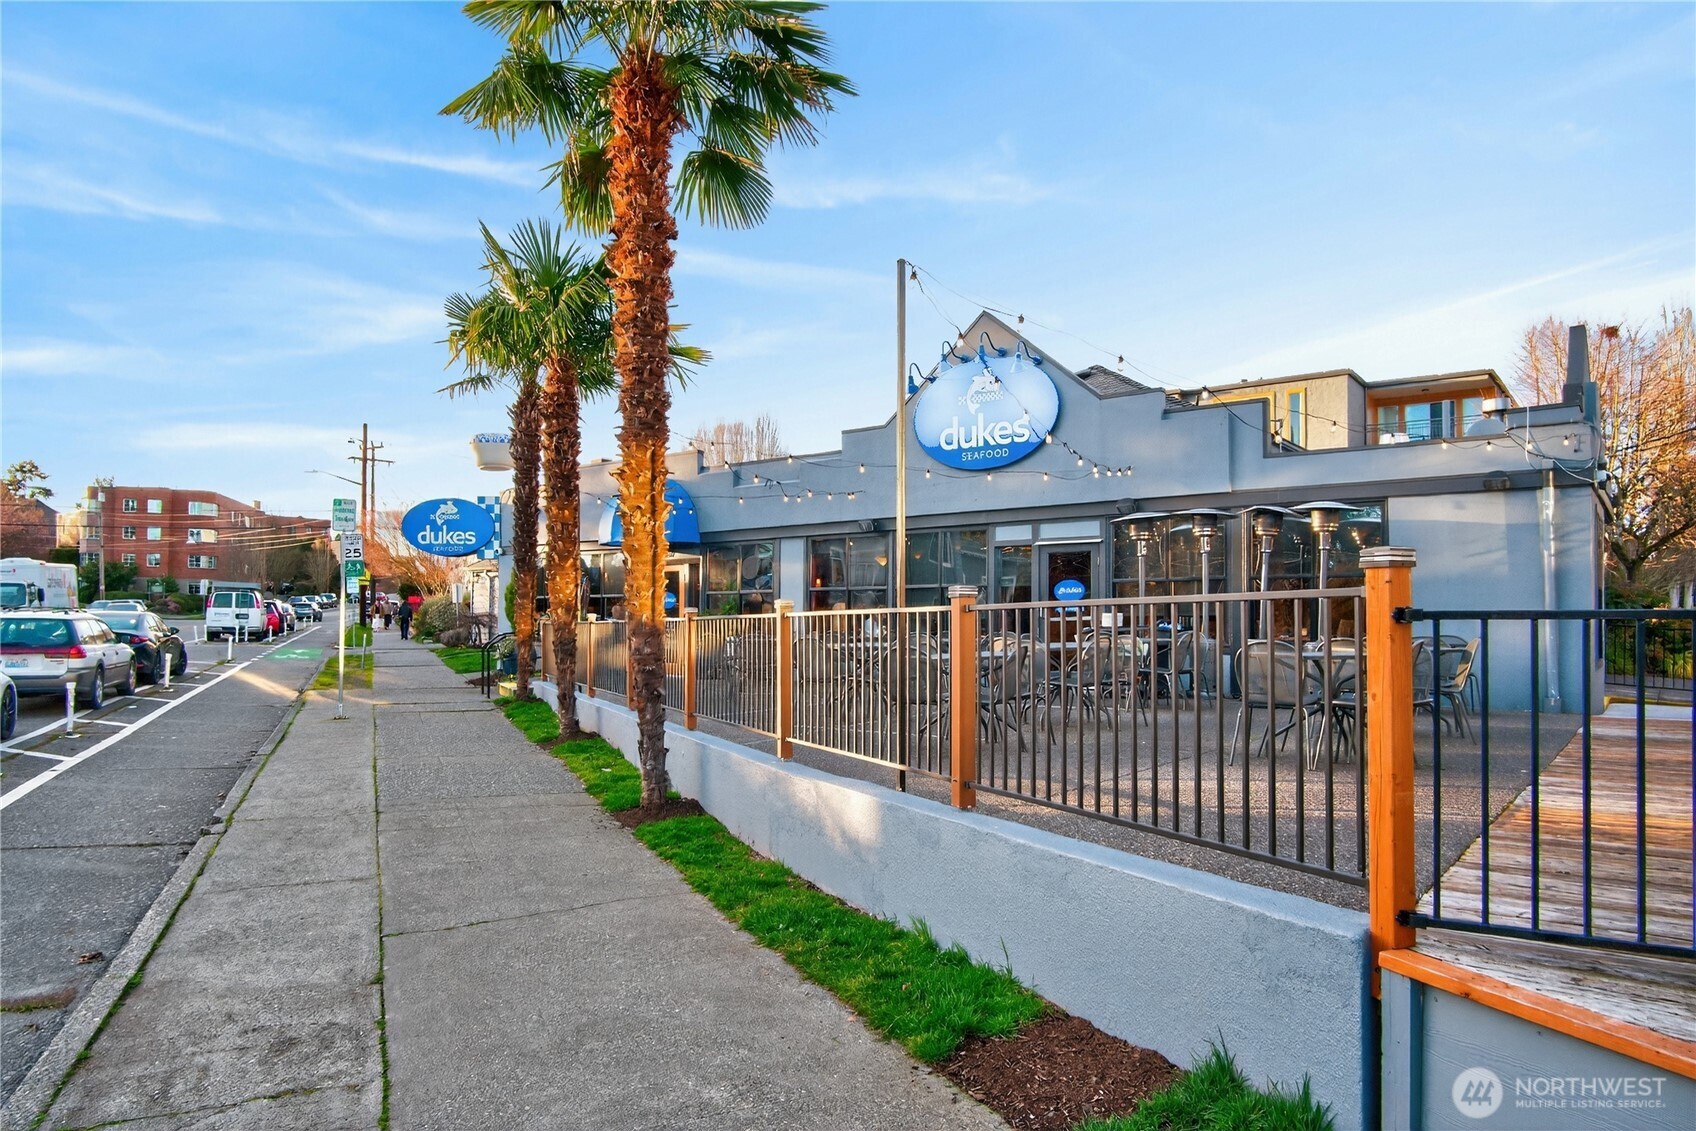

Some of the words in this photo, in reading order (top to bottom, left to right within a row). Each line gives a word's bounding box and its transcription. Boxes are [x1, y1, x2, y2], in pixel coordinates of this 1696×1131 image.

[940, 413, 1030, 450] dukes
[961, 448, 1009, 461] SEAFOOD
[417, 524, 476, 545] dukes
[345, 548, 361, 558] 25
